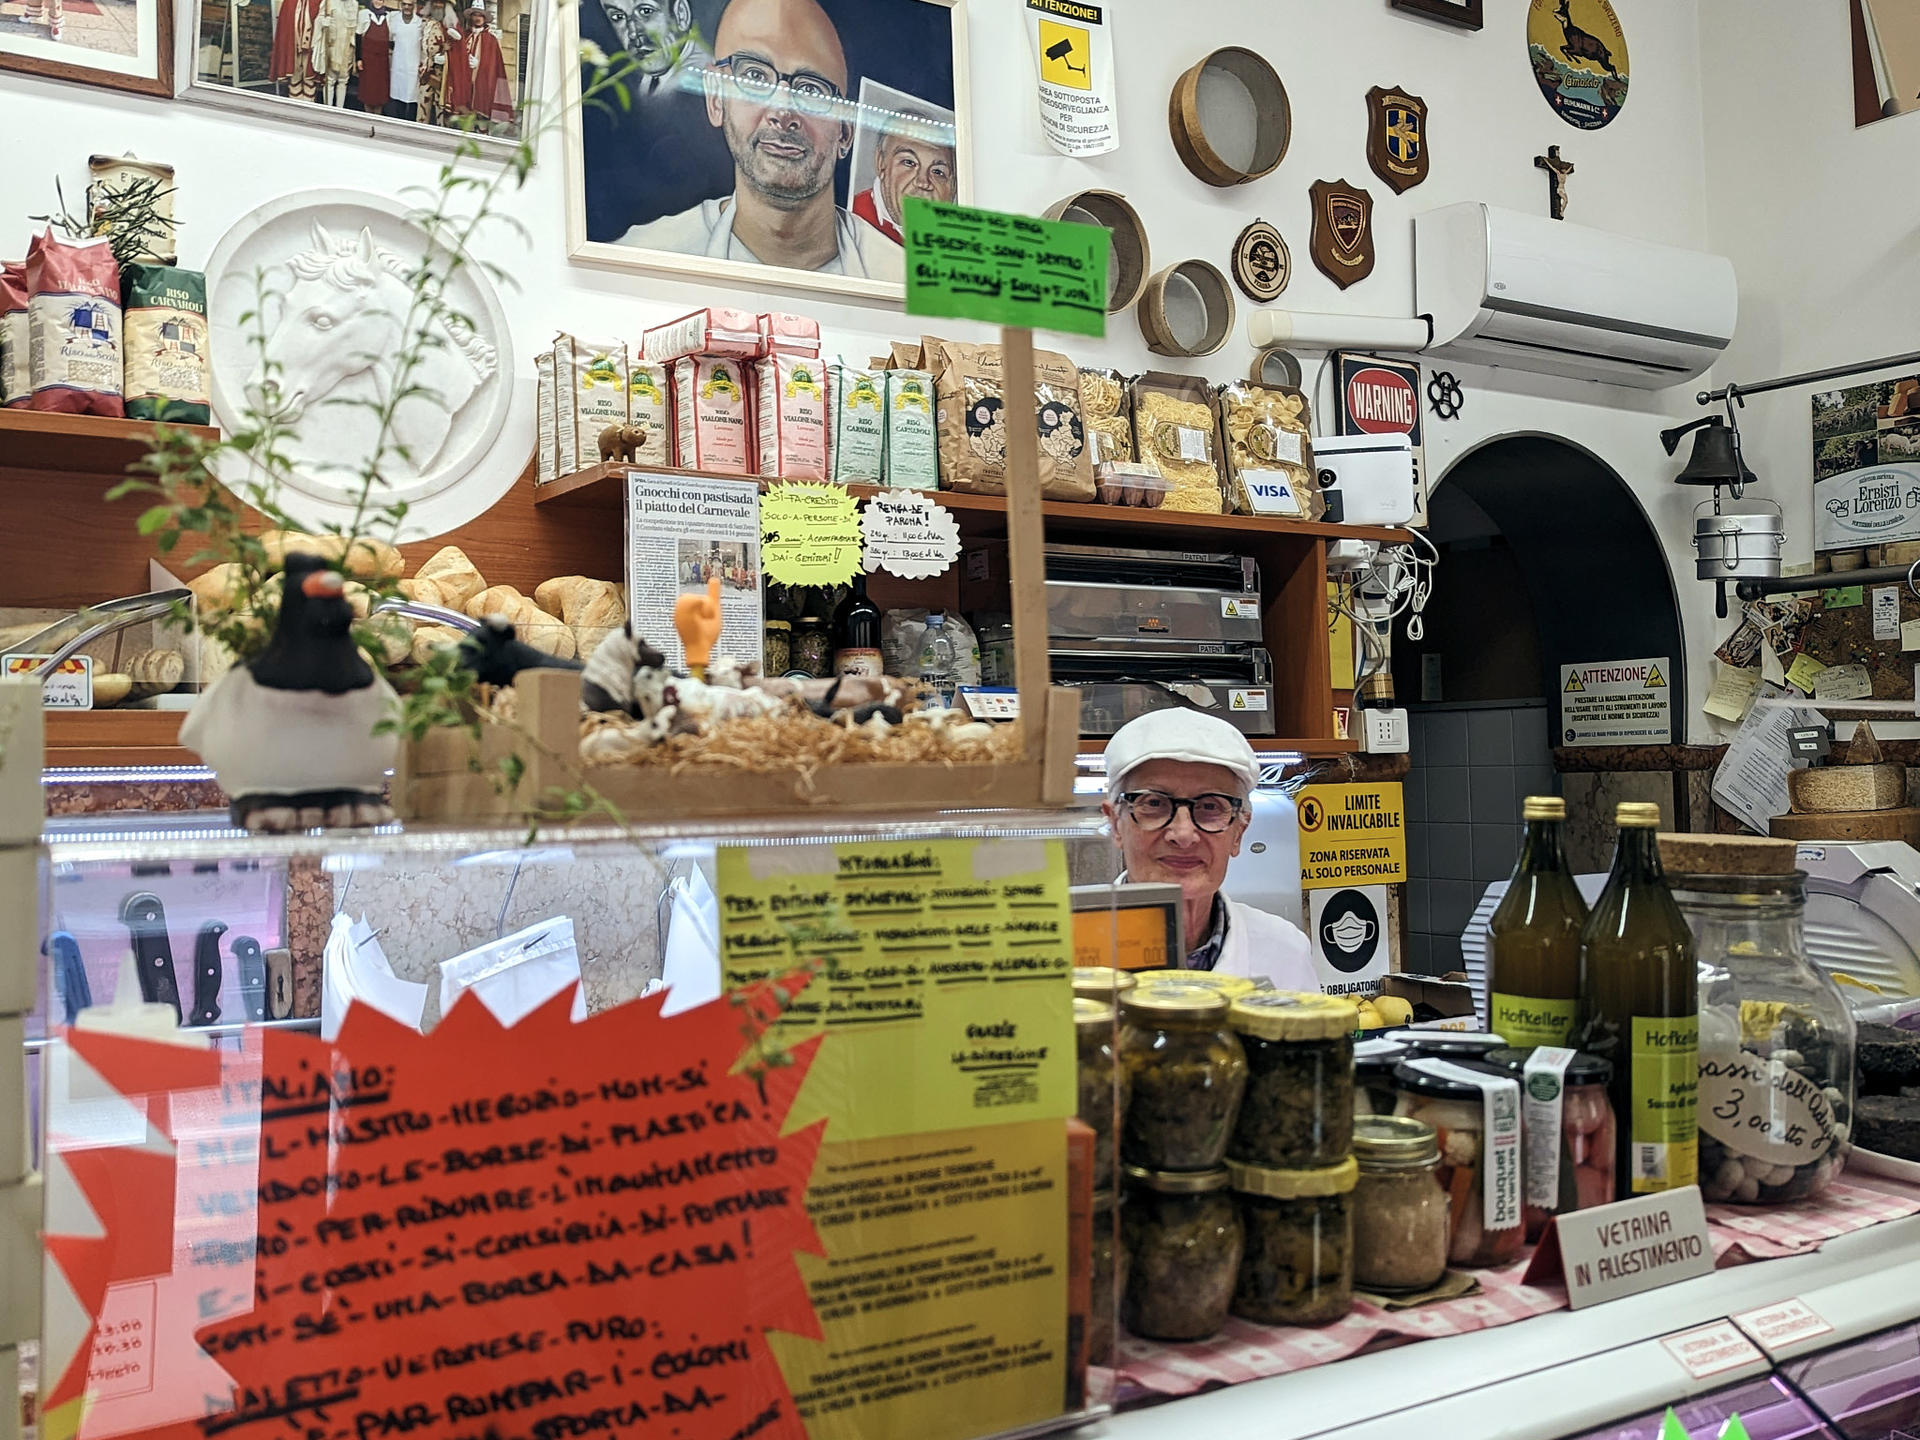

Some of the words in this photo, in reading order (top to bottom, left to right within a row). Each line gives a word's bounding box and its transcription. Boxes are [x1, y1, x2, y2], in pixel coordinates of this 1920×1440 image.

[1053, 90, 1101, 105] SOTTOPOSTA
[1059, 112, 1073, 123] PER
[1066, 124, 1109, 135] SICUREZZA
[166, 287, 190, 300] RISO
[150, 296, 204, 314] CARNAROLI
[1352, 381, 1413, 426] WARNING
[700, 415, 729, 423] VIALONE
[634, 484, 680, 500] Gnocchi
[681, 490, 701, 501] con
[703, 491, 754, 506] pastisada
[1250, 484, 1291, 499] VISA
[635, 499, 643, 511] il
[644, 501, 677, 514] piatto
[678, 502, 696, 515] del
[696, 503, 751, 518] Carnevale
[1853, 496, 1902, 515] Lorenzo
[1183, 553, 1209, 562] PATENT
[1199, 645, 1225, 654] PATENT
[1582, 666, 1648, 684] ATTENZIONE
[1574, 695, 1597, 704] PRESTARE
[1598, 695, 1605, 703] LA
[1627, 693, 1656, 701] ATTENZIONE
[1592, 704, 1605, 712] TUTTI
[1614, 703, 1641, 711] STRUMENTI
[1648, 701, 1668, 710] LAVORO
[1601, 712, 1607, 720] LE
[1607, 712, 1625, 720] NORME
[1344, 793, 1381, 812] LIMITE
[1327, 811, 1400, 832] INVALICABILE
[1309, 851, 1337, 863] ZONA
[1341, 846, 1390, 861] RISERVATA
[1300, 867, 1314, 880] AL
[1315, 866, 1342, 880] SOLO
[1344, 861, 1400, 877] PERSONALE
[1499, 1005, 1569, 1026] Hofkeller
[1507, 1146, 1516, 1206] verdure
[1494, 1150, 1506, 1223] bouquet
[1596, 1210, 1673, 1249] VETRINA
[1574, 1262, 1592, 1288] IN
[1597, 1234, 1703, 1282] ALLESTIMENTO
